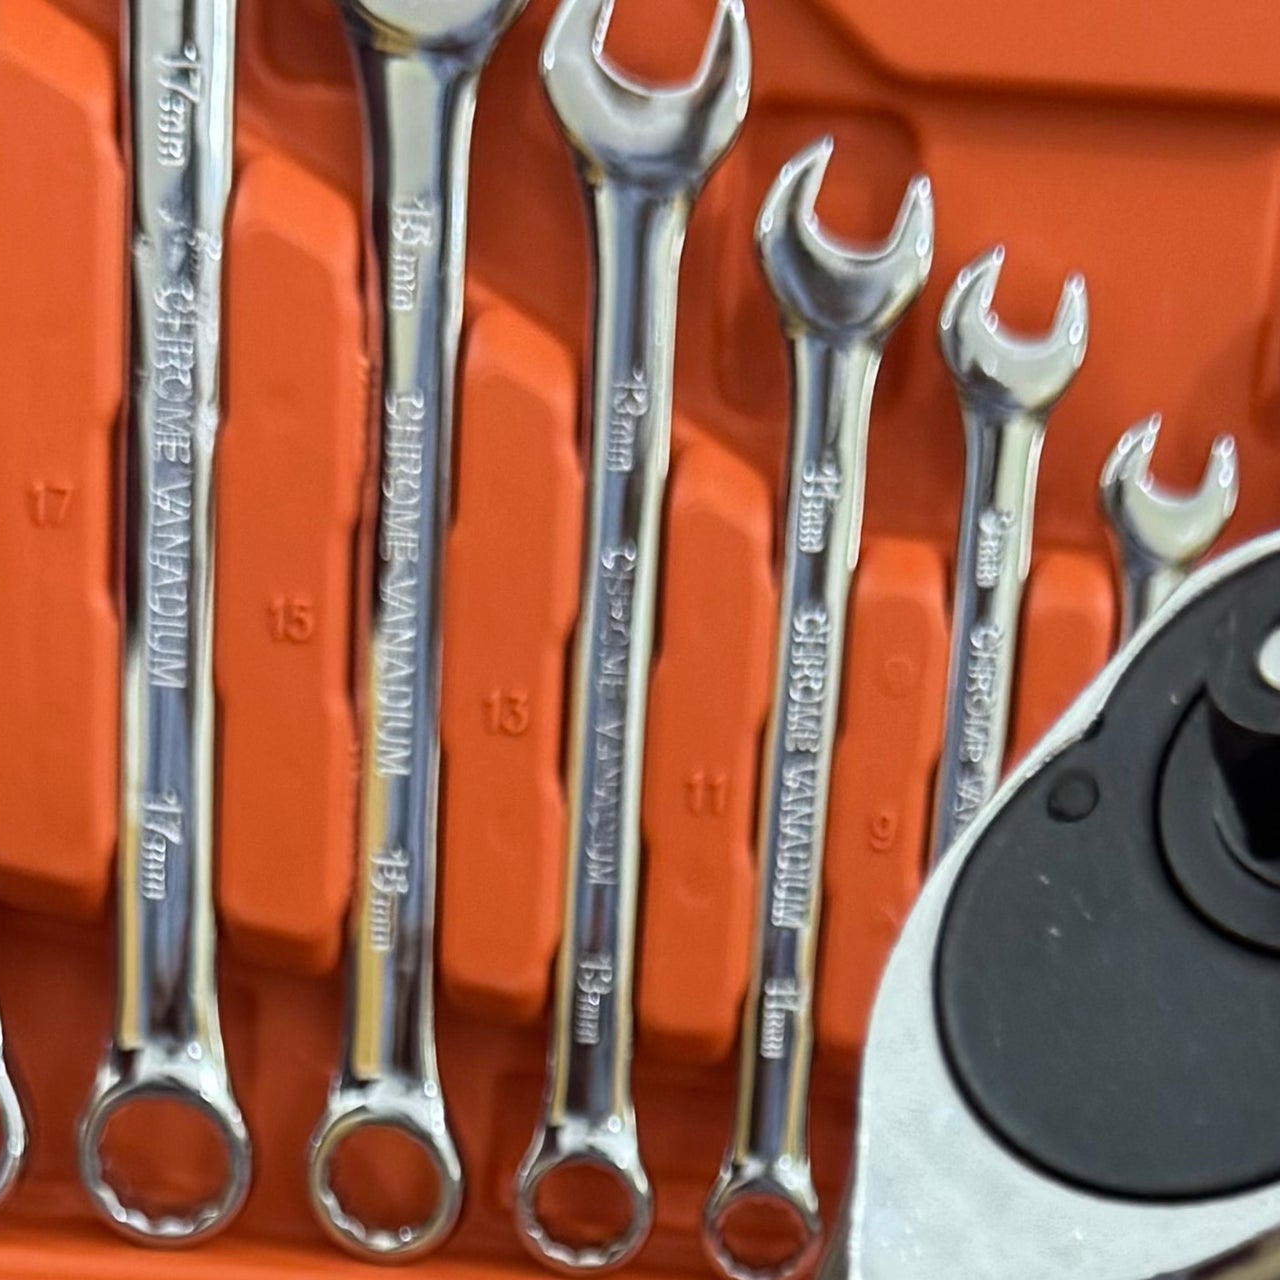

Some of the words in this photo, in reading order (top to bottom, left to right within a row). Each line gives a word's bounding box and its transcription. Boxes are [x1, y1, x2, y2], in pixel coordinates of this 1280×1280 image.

[151, 284, 197, 464] CHROME
[27, 480, 78, 528] 17
[380, 391, 426, 564] CHROME
[144, 475, 194, 690] VANADIUM
[266, 599, 314, 645] 15
[375, 572, 421, 778] VANADIUM
[784, 604, 833, 754] CHROME
[684, 770, 727, 815] 11
[770, 765, 822, 930] VANADIUM
[868, 808, 898, 853] 9
